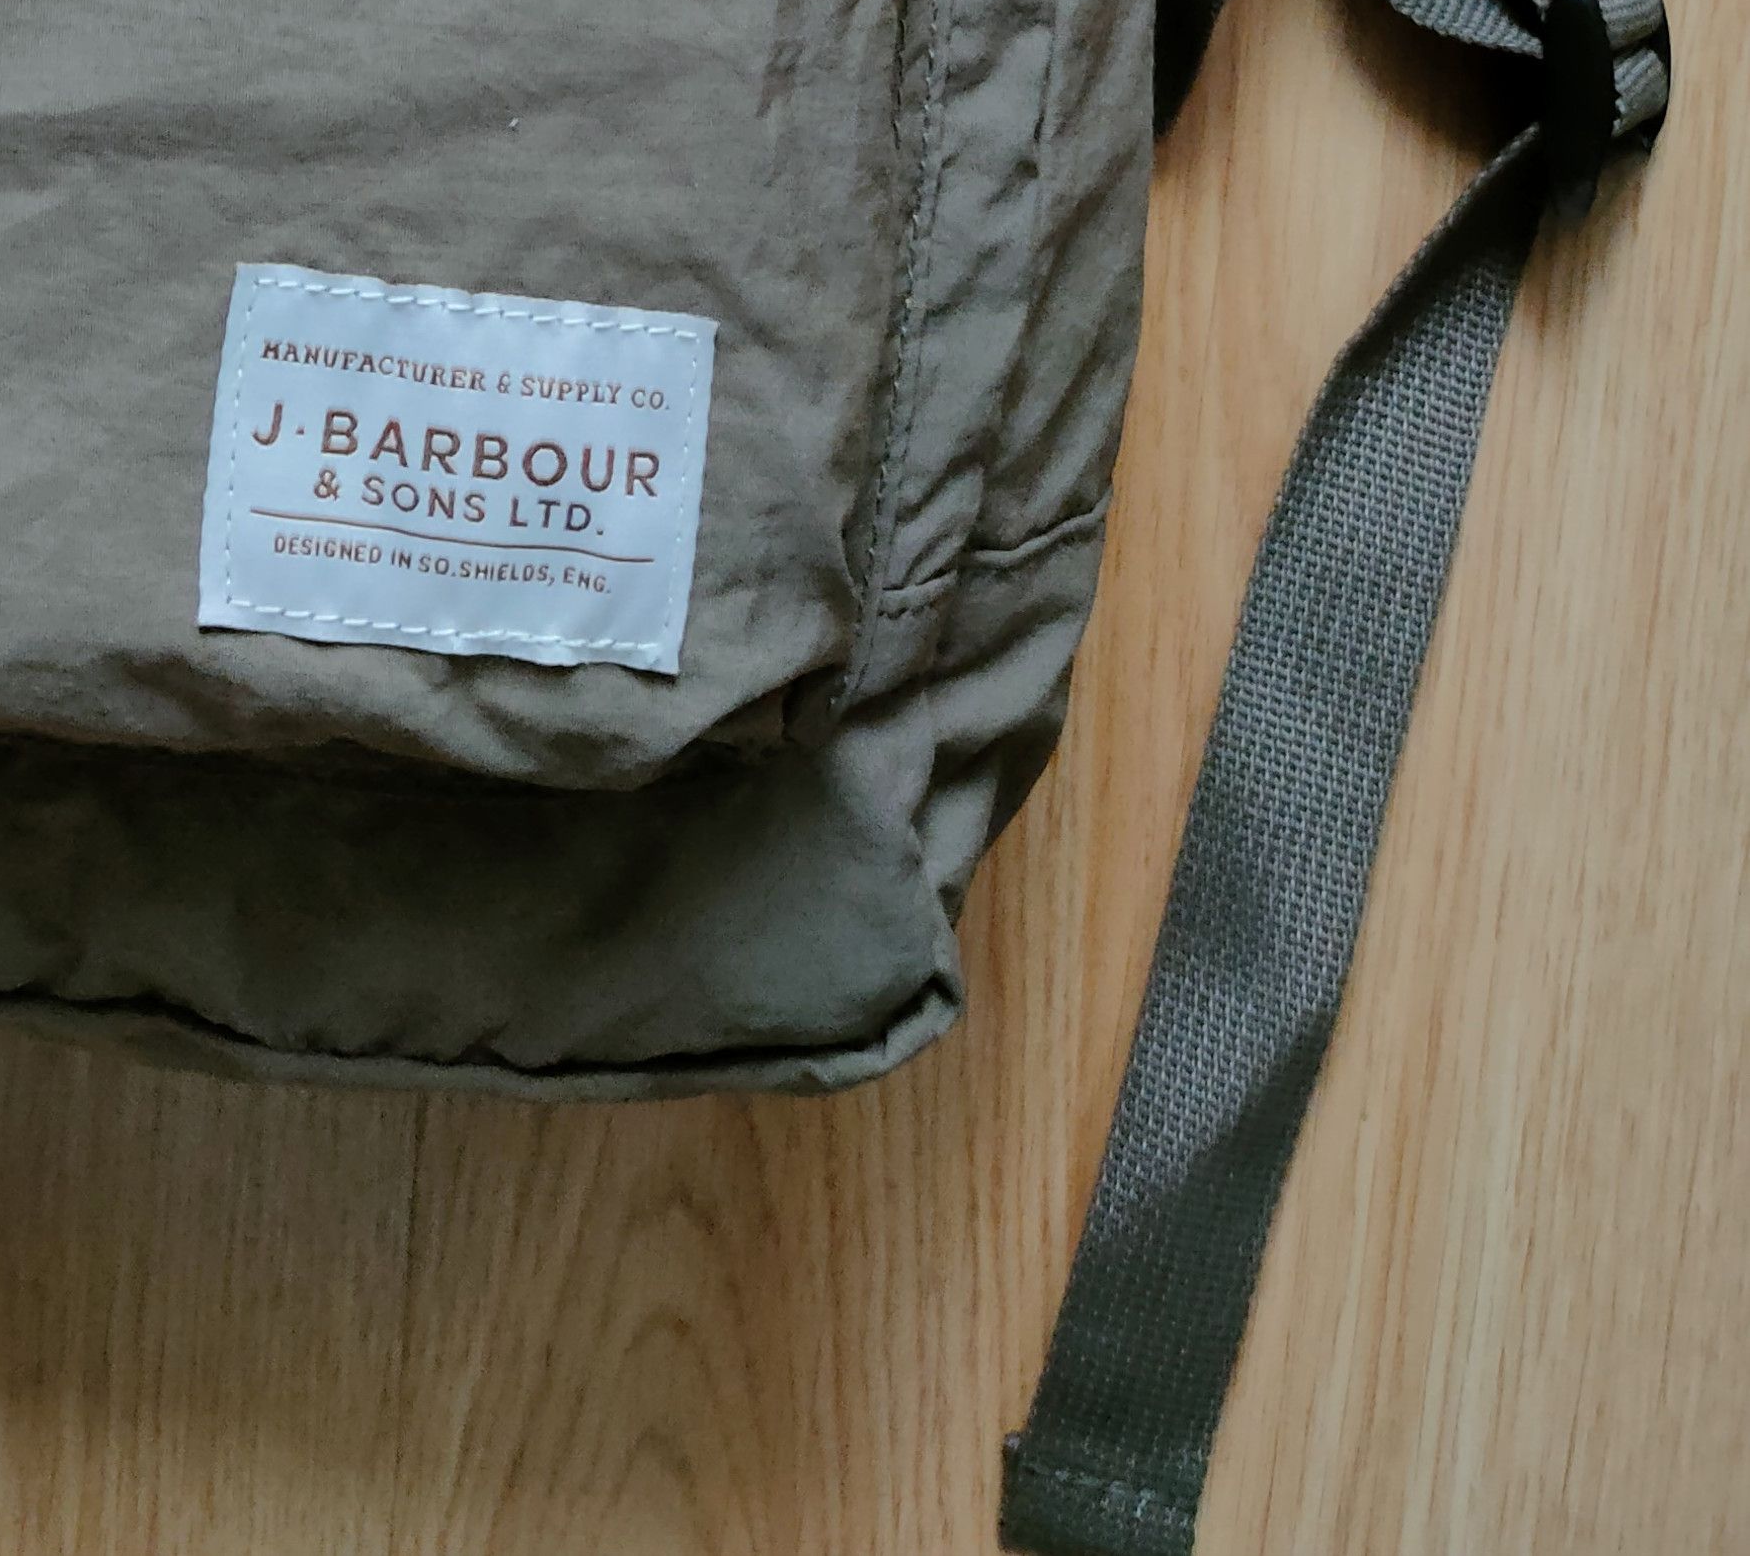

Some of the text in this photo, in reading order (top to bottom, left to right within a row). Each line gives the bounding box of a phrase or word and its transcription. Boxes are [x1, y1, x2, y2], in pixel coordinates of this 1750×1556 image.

[262, 339, 670, 410] MANUFACTURER & SUPPLY CO.
[314, 468, 605, 536] & SONS LTD.
[274, 534, 382, 565] DESIGNED
[391, 548, 411, 569] IN
[563, 568, 611, 594] ENG.
